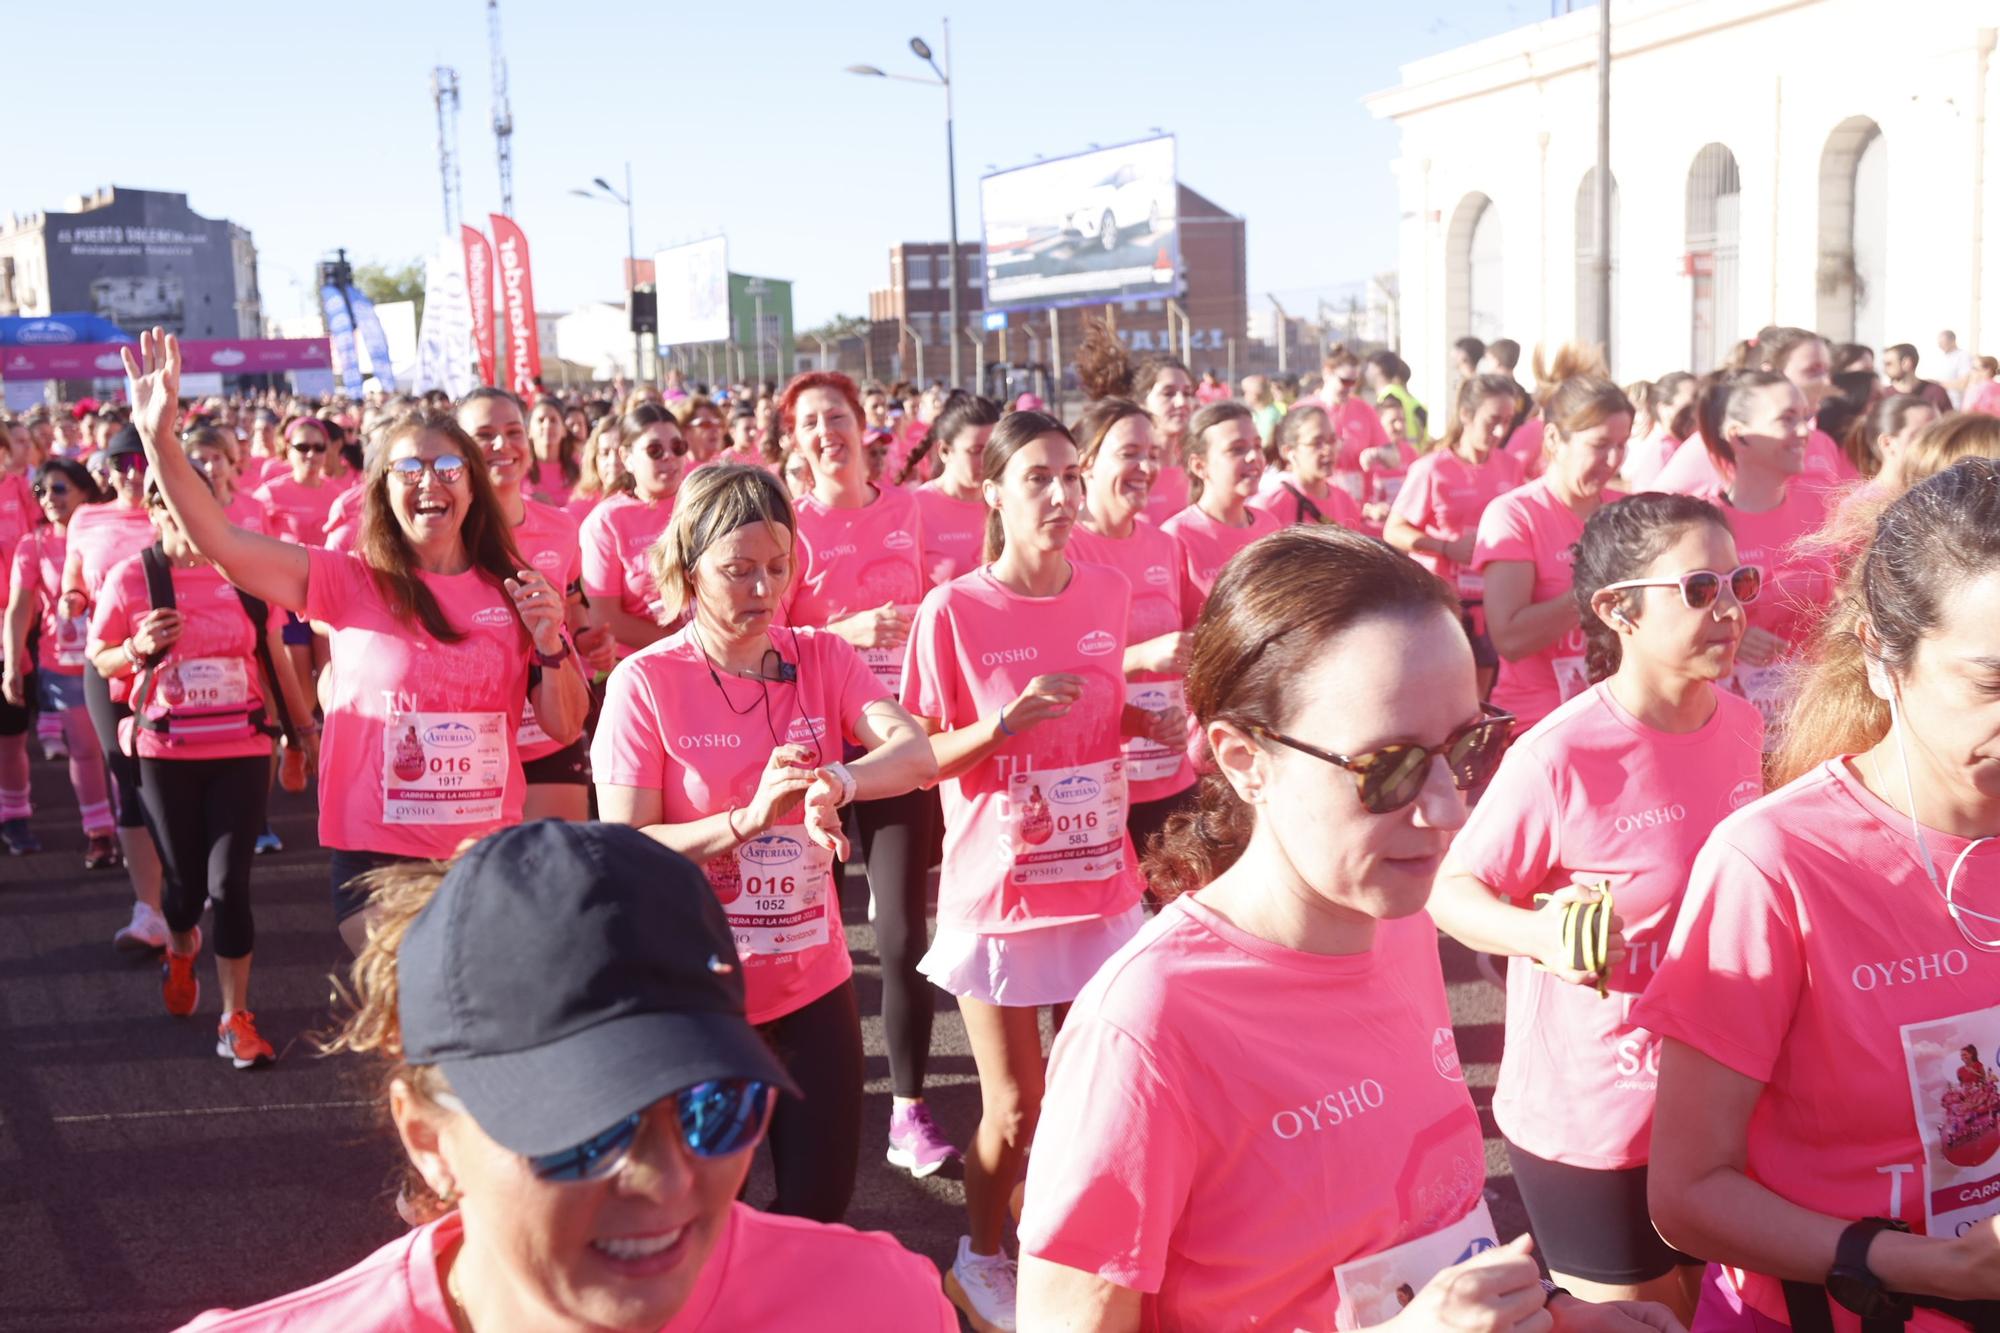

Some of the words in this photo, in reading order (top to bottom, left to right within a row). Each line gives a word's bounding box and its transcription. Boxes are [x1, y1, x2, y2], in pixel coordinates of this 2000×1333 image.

[981, 646, 1038, 666] OYSHO
[678, 734, 741, 749] OYSHO
[429, 757, 471, 773] 016
[438, 776, 463, 786] 1917
[436, 791, 446, 800] DE
[447, 791, 457, 799] LA
[396, 806, 435, 816] OYSHO
[1057, 811, 1098, 832] 016
[1615, 804, 1686, 834] OYSHO
[1068, 833, 1089, 845] 583
[745, 845, 798, 858] ASTURIANA
[1024, 866, 1064, 877] OYSHO
[746, 876, 795, 895] 016
[755, 899, 785, 910] 1052
[752, 917, 765, 925] DE
[766, 917, 778, 926] LA
[779, 914, 802, 925] MUJER
[1851, 949, 1969, 991] OYSHO
[1272, 1078, 1385, 1140] OYSHO
